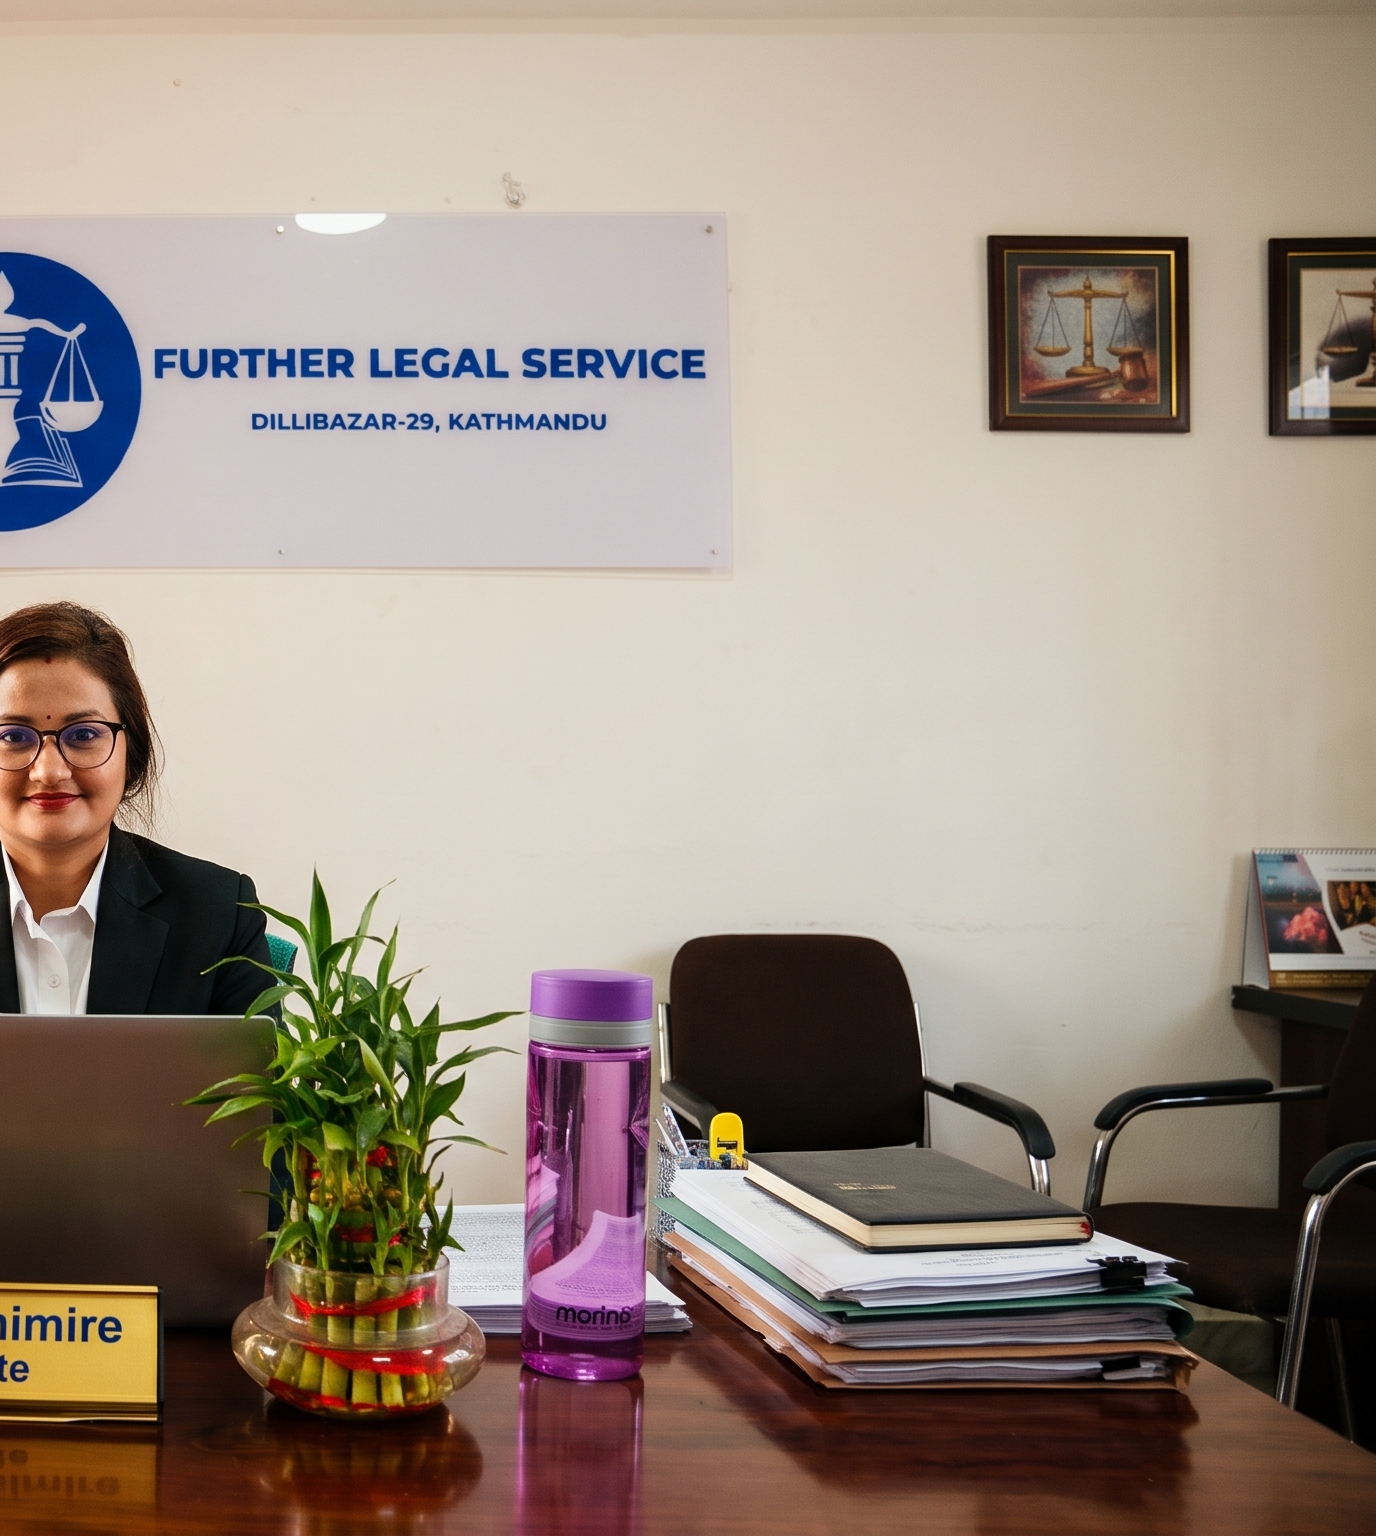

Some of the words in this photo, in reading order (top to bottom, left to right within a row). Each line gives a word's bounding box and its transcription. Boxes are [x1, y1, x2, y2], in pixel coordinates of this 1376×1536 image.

[154, 347, 355, 380] FURTHER
[369, 347, 510, 380] LEGAL
[522, 347, 707, 380] SERVICE
[251, 413, 441, 434] DILLIBAZAR-29,
[449, 413, 607, 431] KATHMANDU
